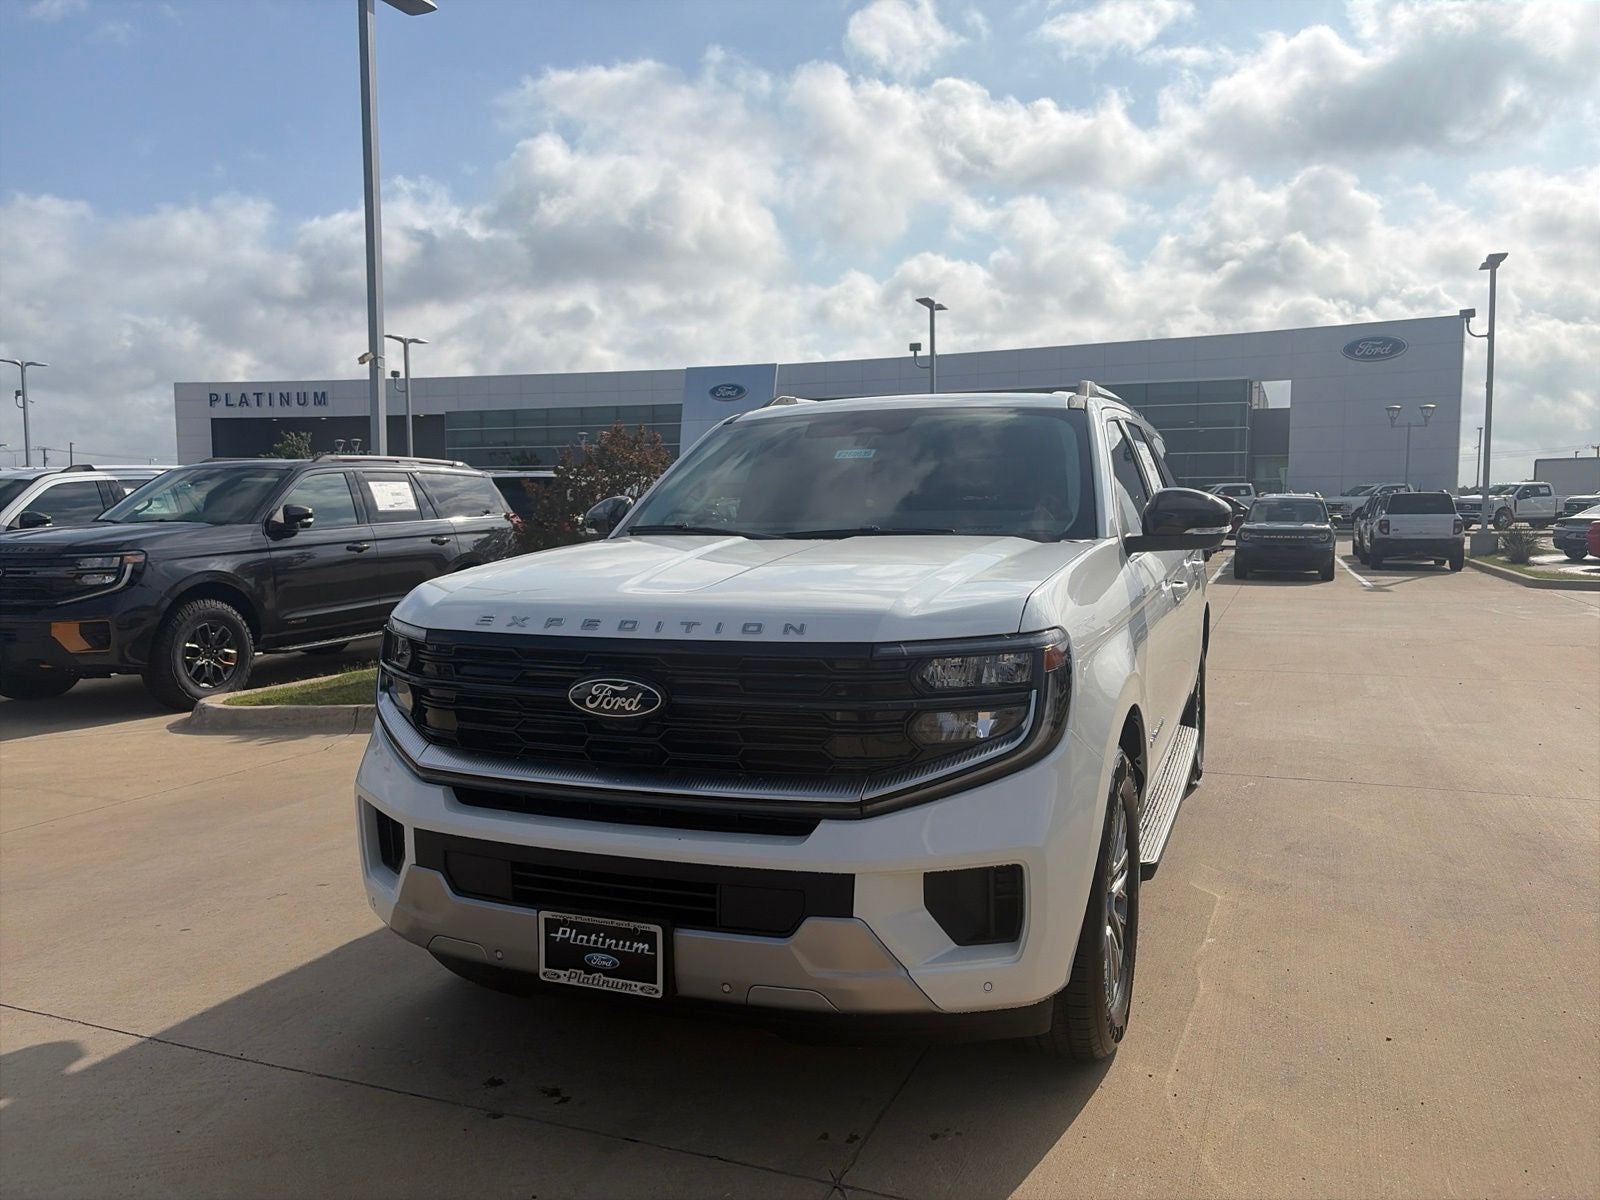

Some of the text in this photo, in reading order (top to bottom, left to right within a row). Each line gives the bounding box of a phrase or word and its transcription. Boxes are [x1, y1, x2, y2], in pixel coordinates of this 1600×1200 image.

[1355, 341, 1392, 356] Ford
[208, 391, 328, 407] PLATINUM
[715, 386, 738, 397] Ford
[475, 614, 807, 636] EXPEDITION
[585, 683, 643, 711] Ford
[550, 927, 656, 955] Platinum
[567, 970, 637, 992] Platinum
